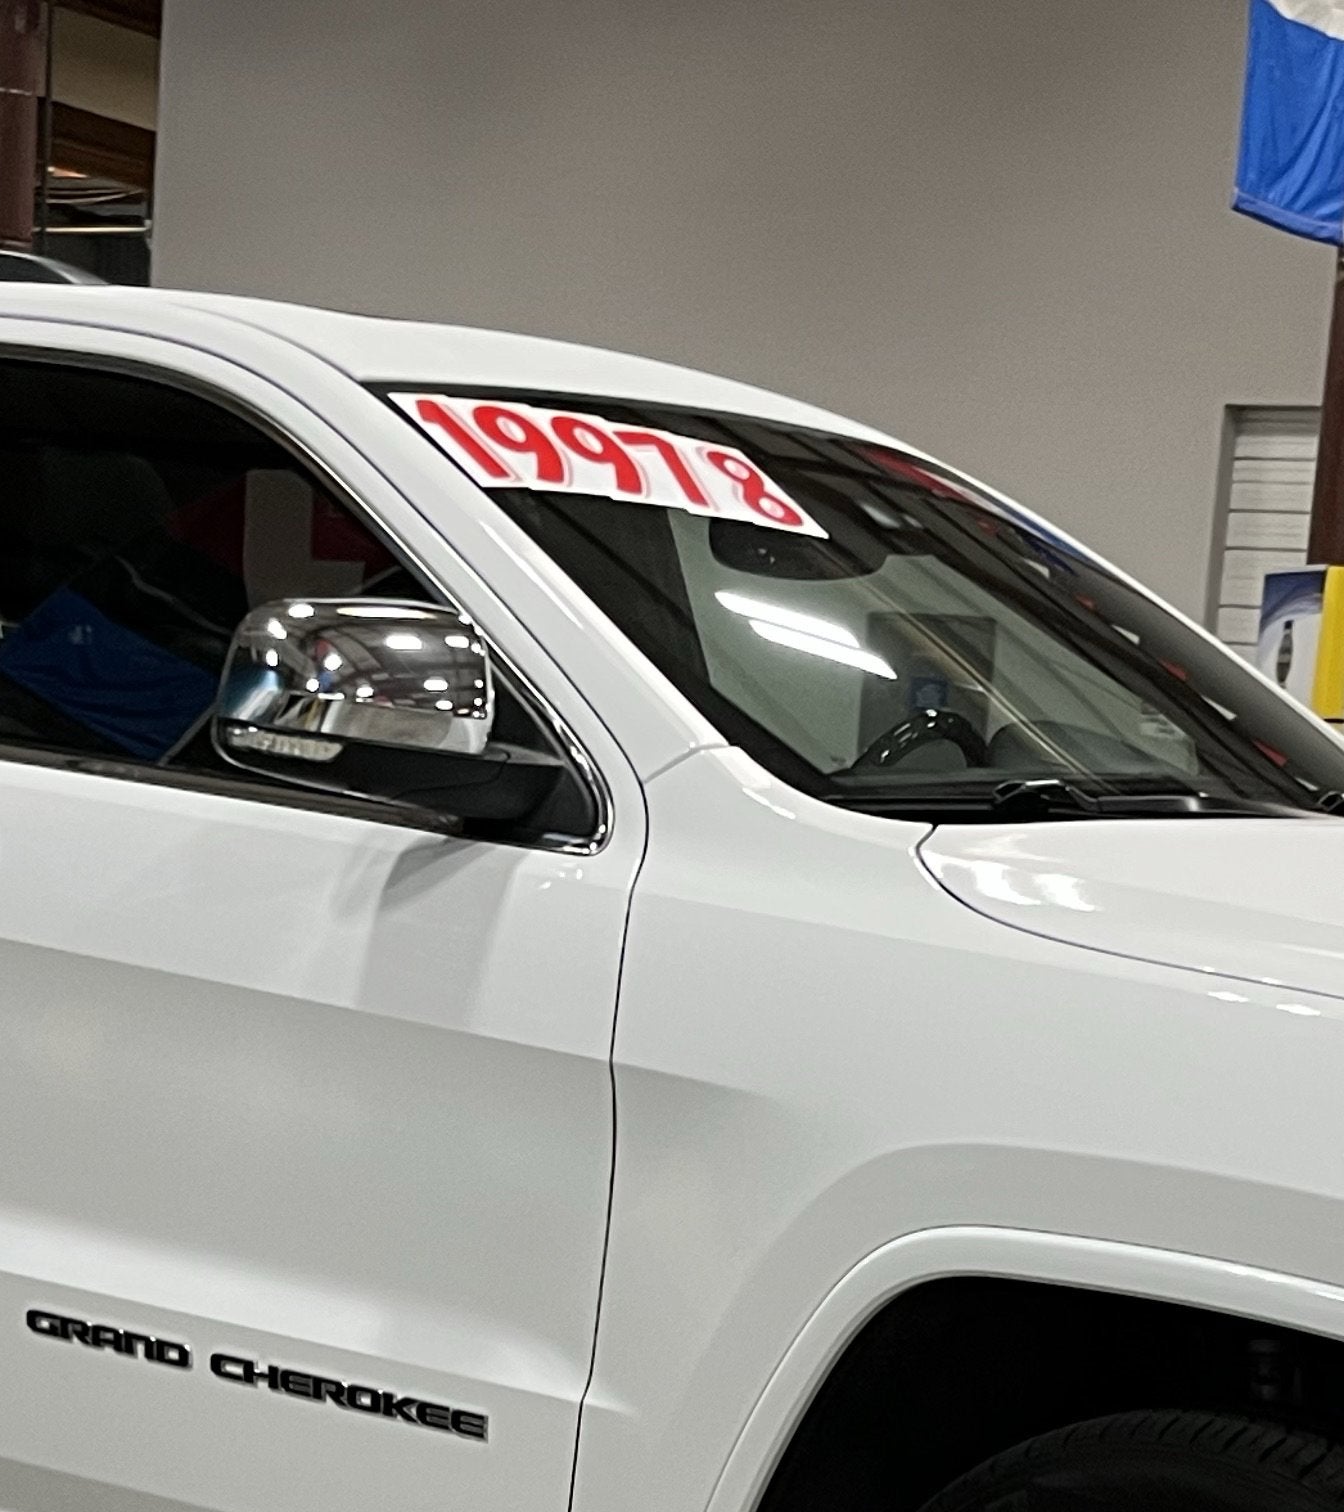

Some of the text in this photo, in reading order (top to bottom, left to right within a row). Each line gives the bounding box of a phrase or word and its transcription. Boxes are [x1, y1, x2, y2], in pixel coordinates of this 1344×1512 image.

[414, 398, 805, 528] 19978
[26, 1309, 490, 1442] GRAND CHEROKEE
